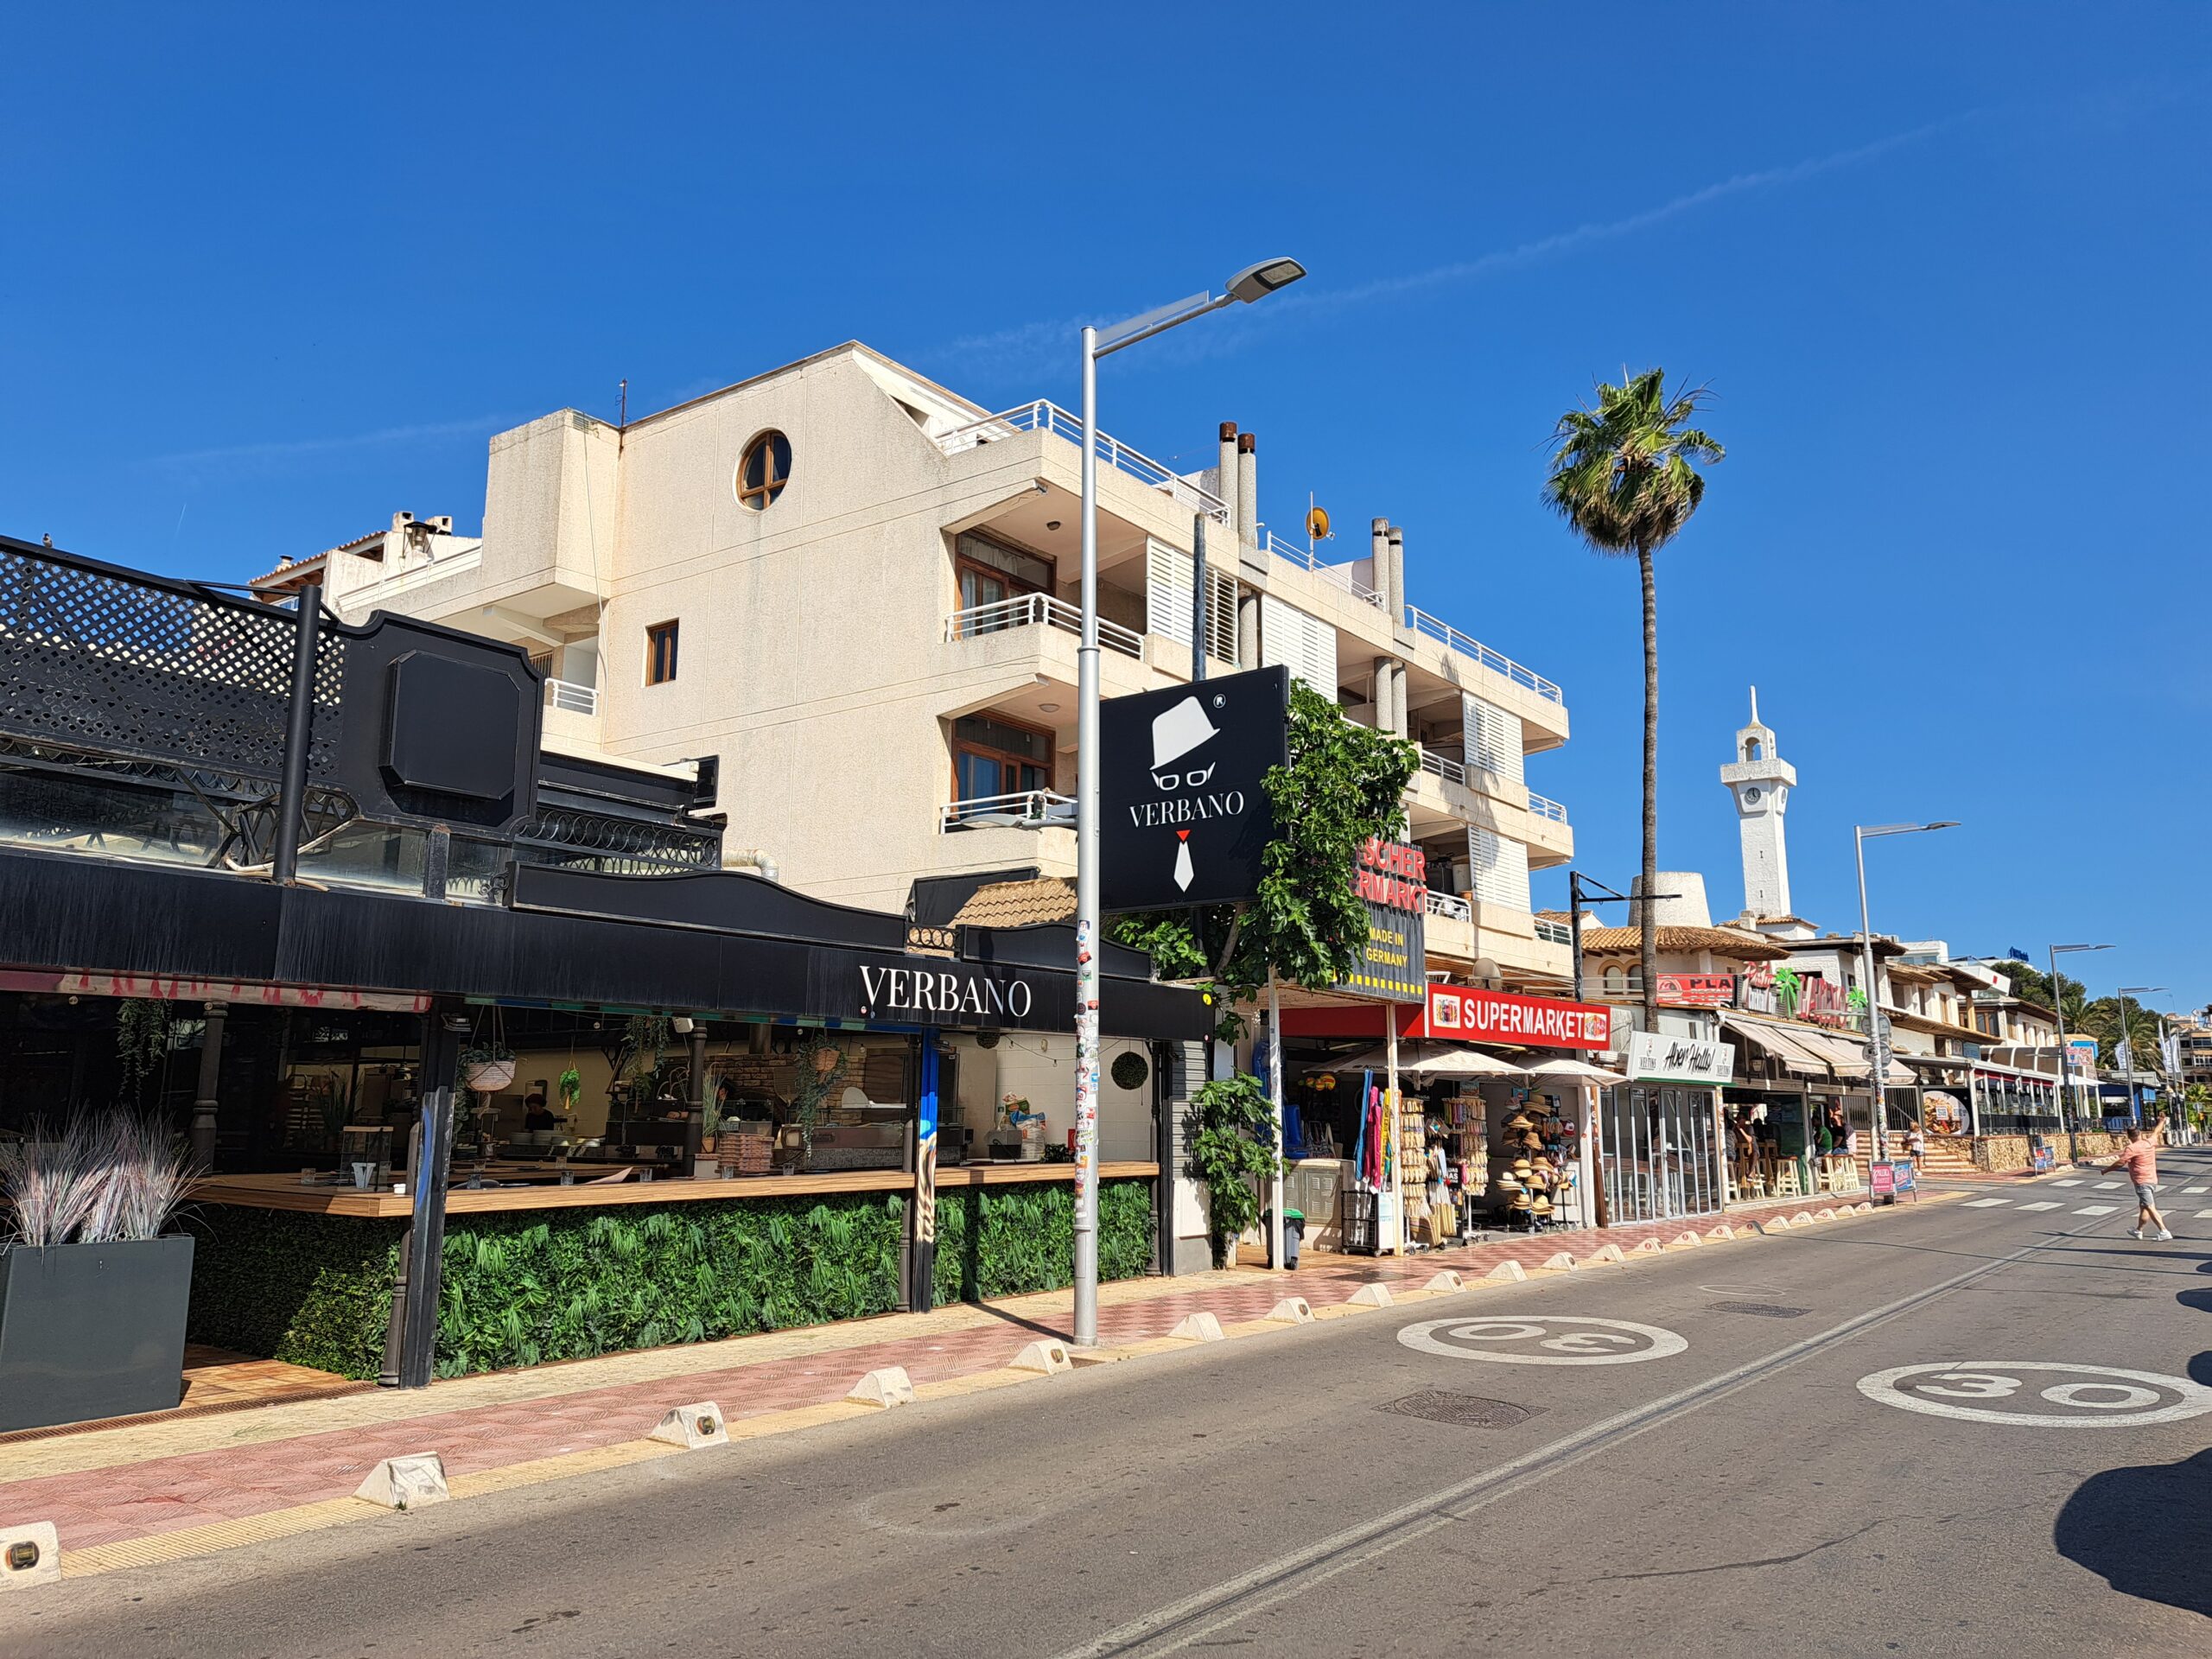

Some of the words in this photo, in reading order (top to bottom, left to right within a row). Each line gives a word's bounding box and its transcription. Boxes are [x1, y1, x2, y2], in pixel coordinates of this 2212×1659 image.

[1128, 790, 1244, 829] VERBANO
[1369, 926, 1394, 944] MADE
[1395, 932, 1404, 947] IN
[1366, 947, 1408, 969] GERMANY
[859, 965, 1032, 1018] VERBANO
[1464, 998, 1585, 1040] SUPERMARKET
[1663, 1040, 1689, 1071] Aber
[1915, 1372, 2161, 1409] 30
